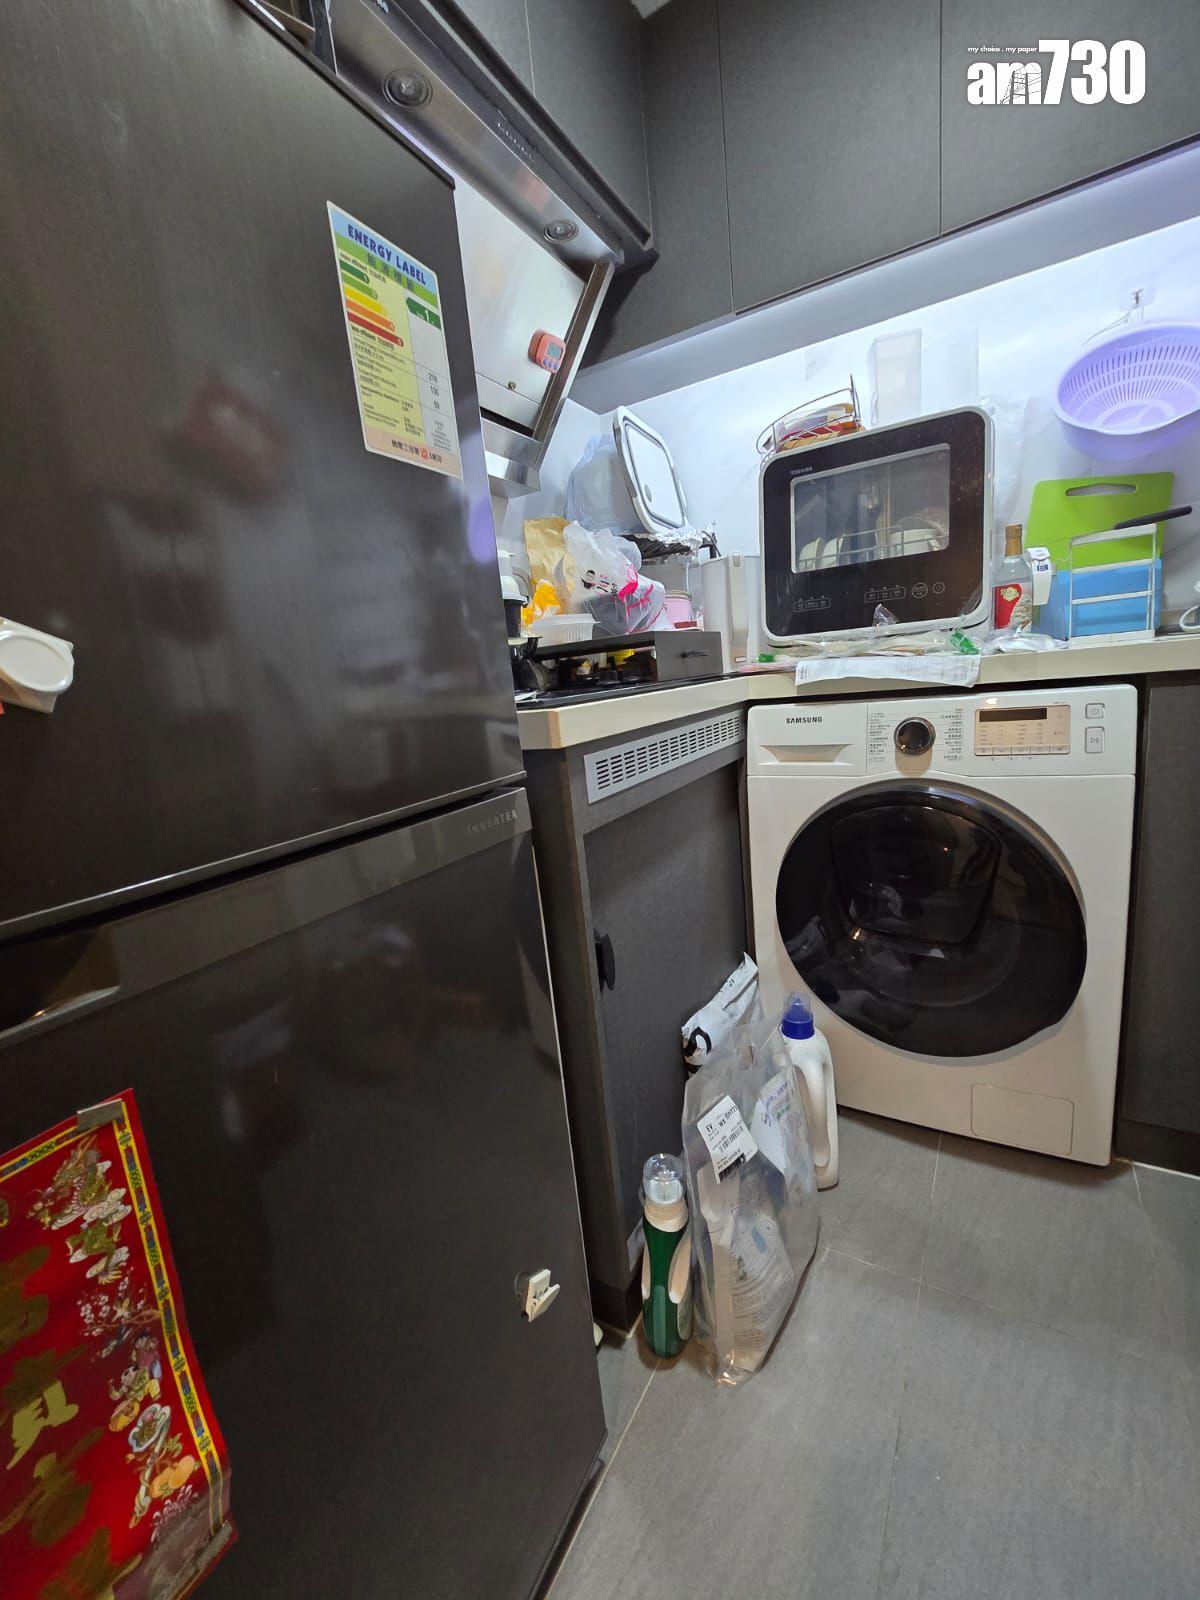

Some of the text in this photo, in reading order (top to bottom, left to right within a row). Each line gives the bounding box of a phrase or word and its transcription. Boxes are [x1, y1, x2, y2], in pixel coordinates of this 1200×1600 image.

[347, 223, 392, 263] ENERGY
[396, 255, 427, 285] LABEL
[424, 310, 430, 323] 1
[786, 716, 823, 724] SAMSUNG
